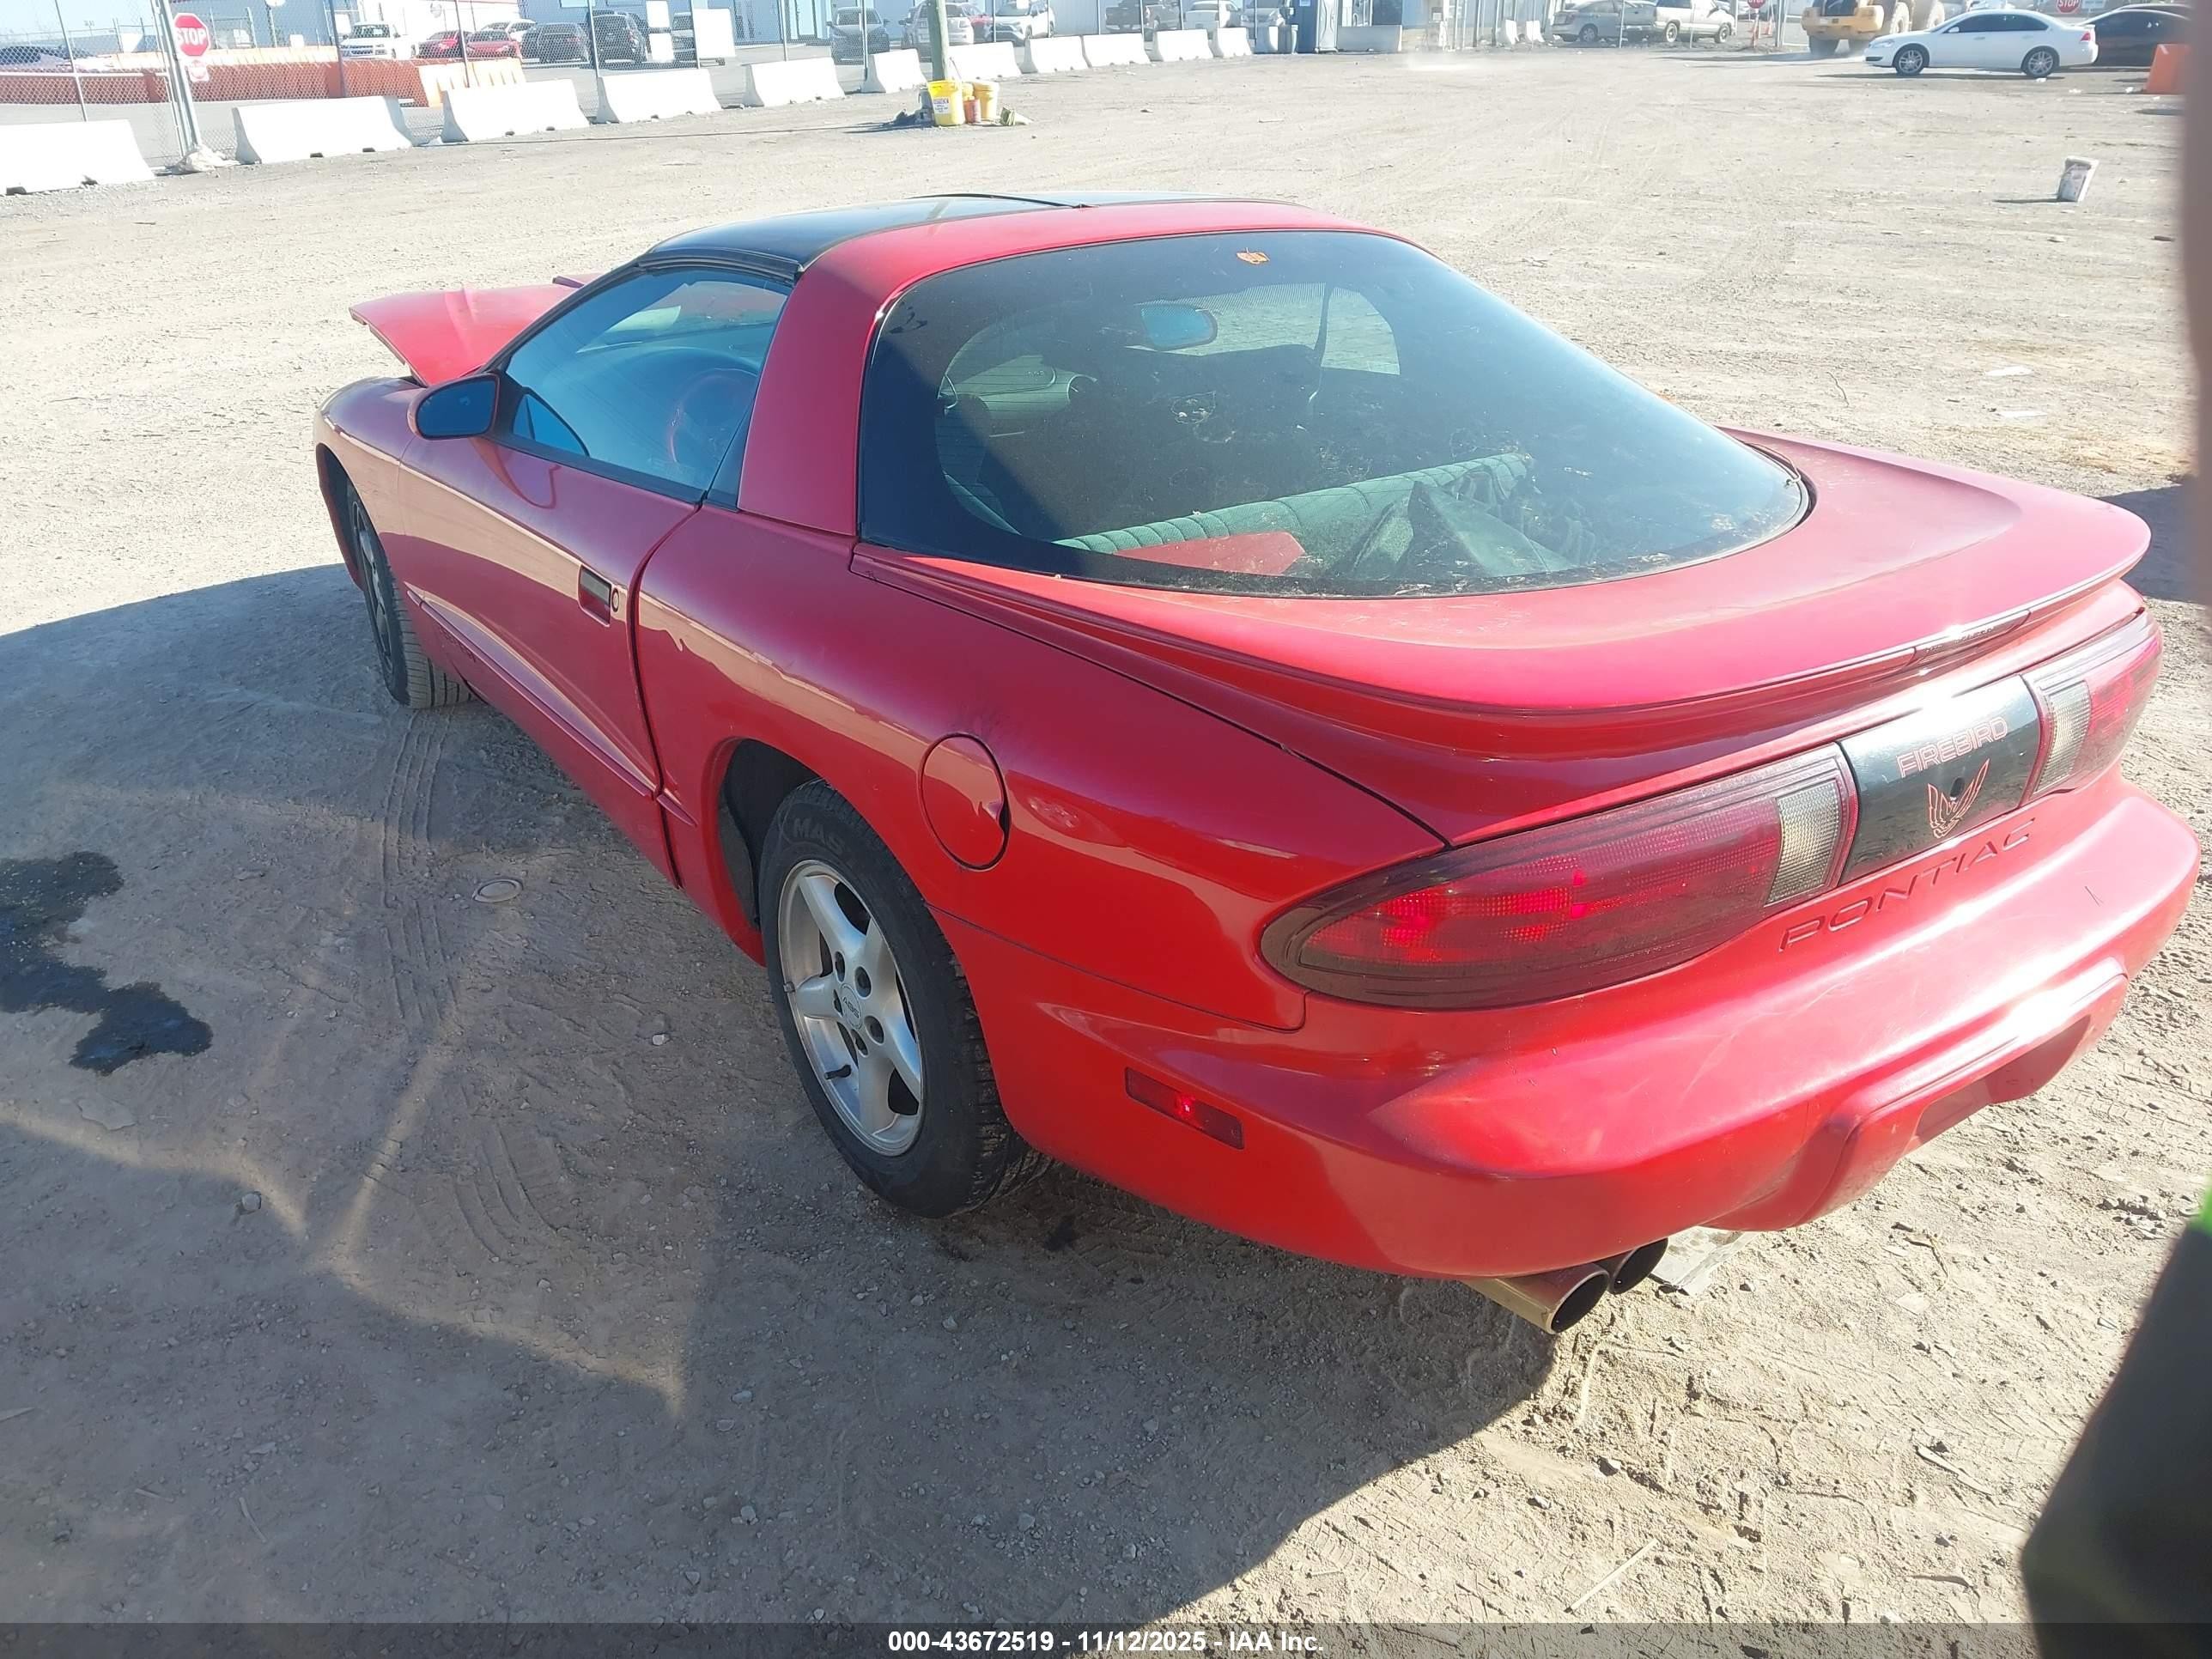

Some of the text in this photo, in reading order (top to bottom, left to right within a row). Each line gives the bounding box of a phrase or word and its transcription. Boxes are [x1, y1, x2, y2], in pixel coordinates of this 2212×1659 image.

[176, 27, 207, 46] STOP
[1896, 717, 2008, 778] FIREBIRD
[1778, 817, 2036, 952] PONTIAC
[842, 996, 860, 1018] ABS
